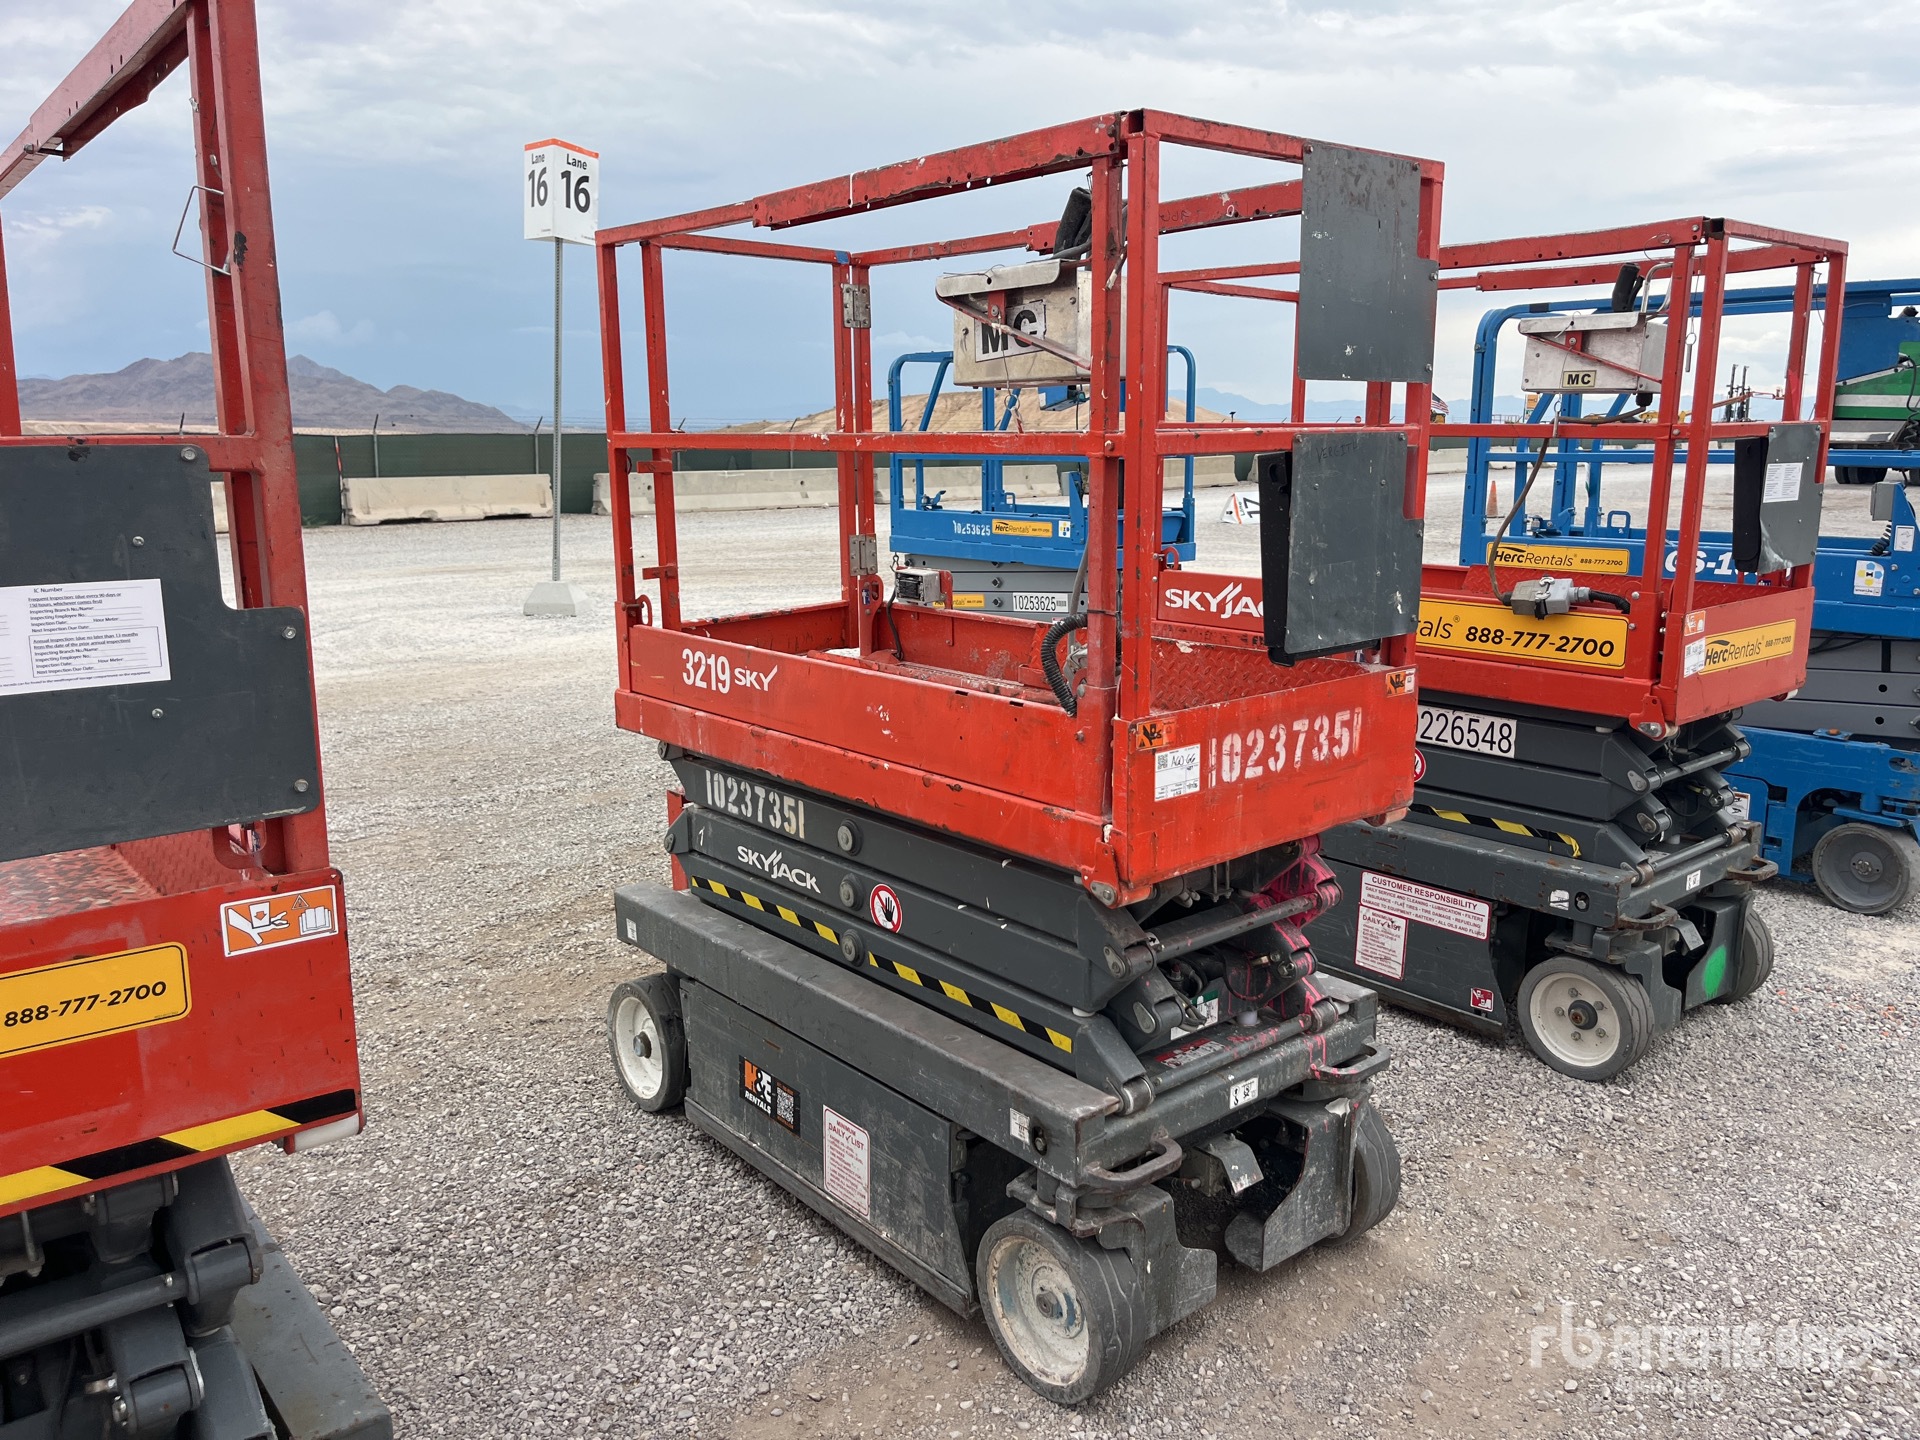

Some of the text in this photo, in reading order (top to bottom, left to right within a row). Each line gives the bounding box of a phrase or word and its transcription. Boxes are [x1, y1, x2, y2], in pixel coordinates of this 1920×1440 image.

[531, 153, 545, 165] Lane
[566, 153, 588, 170] Lane
[528, 166, 548, 208] 16
[560, 169, 591, 213] 16
[1567, 373, 1592, 386] MC
[1238, 501, 1246, 516] Lane
[952, 519, 991, 536] 10253625
[995, 522, 1030, 534] HercRentals
[1495, 547, 1623, 567] HercRentals 888-777-2700
[1013, 595, 1056, 612] 10253625
[1465, 625, 1615, 658] 888-777-2700
[1704, 640, 1762, 666] HercRentals
[681, 647, 778, 694] 3219 SKY
[1416, 710, 1512, 754] 226548
[1208, 707, 1362, 788] 10237351
[705, 769, 805, 839] 10237351
[736, 845, 821, 894] SKYJACK
[1372, 876, 1477, 910] CUSTOMER RESPONSIBILITY
[1378, 889, 1397, 898] SERVICE
[1406, 897, 1428, 907] CLEANING
[1431, 904, 1462, 917] LUBRICATION
[1464, 913, 1484, 923] FILTERS
[1362, 898, 1380, 908] DAMAGE
[1387, 905, 1412, 917] EQUIPMENT
[1414, 913, 1435, 923] BATTERY
[1446, 922, 1458, 930] OILS
[1362, 914, 1382, 926] DAILY
[1367, 893, 1391, 904] INSURANCE
[1405, 904, 1419, 912] TIRES
[1421, 907, 1432, 915] TIRE
[1432, 911, 1452, 921] DAMAGE
[1454, 917, 1481, 929] REFUELING
[1371, 912, 1393, 922] MINIMUM
[3, 981, 167, 1028] 888-777-2700
[745, 1060, 771, 1104] H&E
[745, 1090, 771, 1115] RENTALS
[829, 1122, 864, 1150] DAILY LIST
[836, 1120, 856, 1136] MINIMUM
